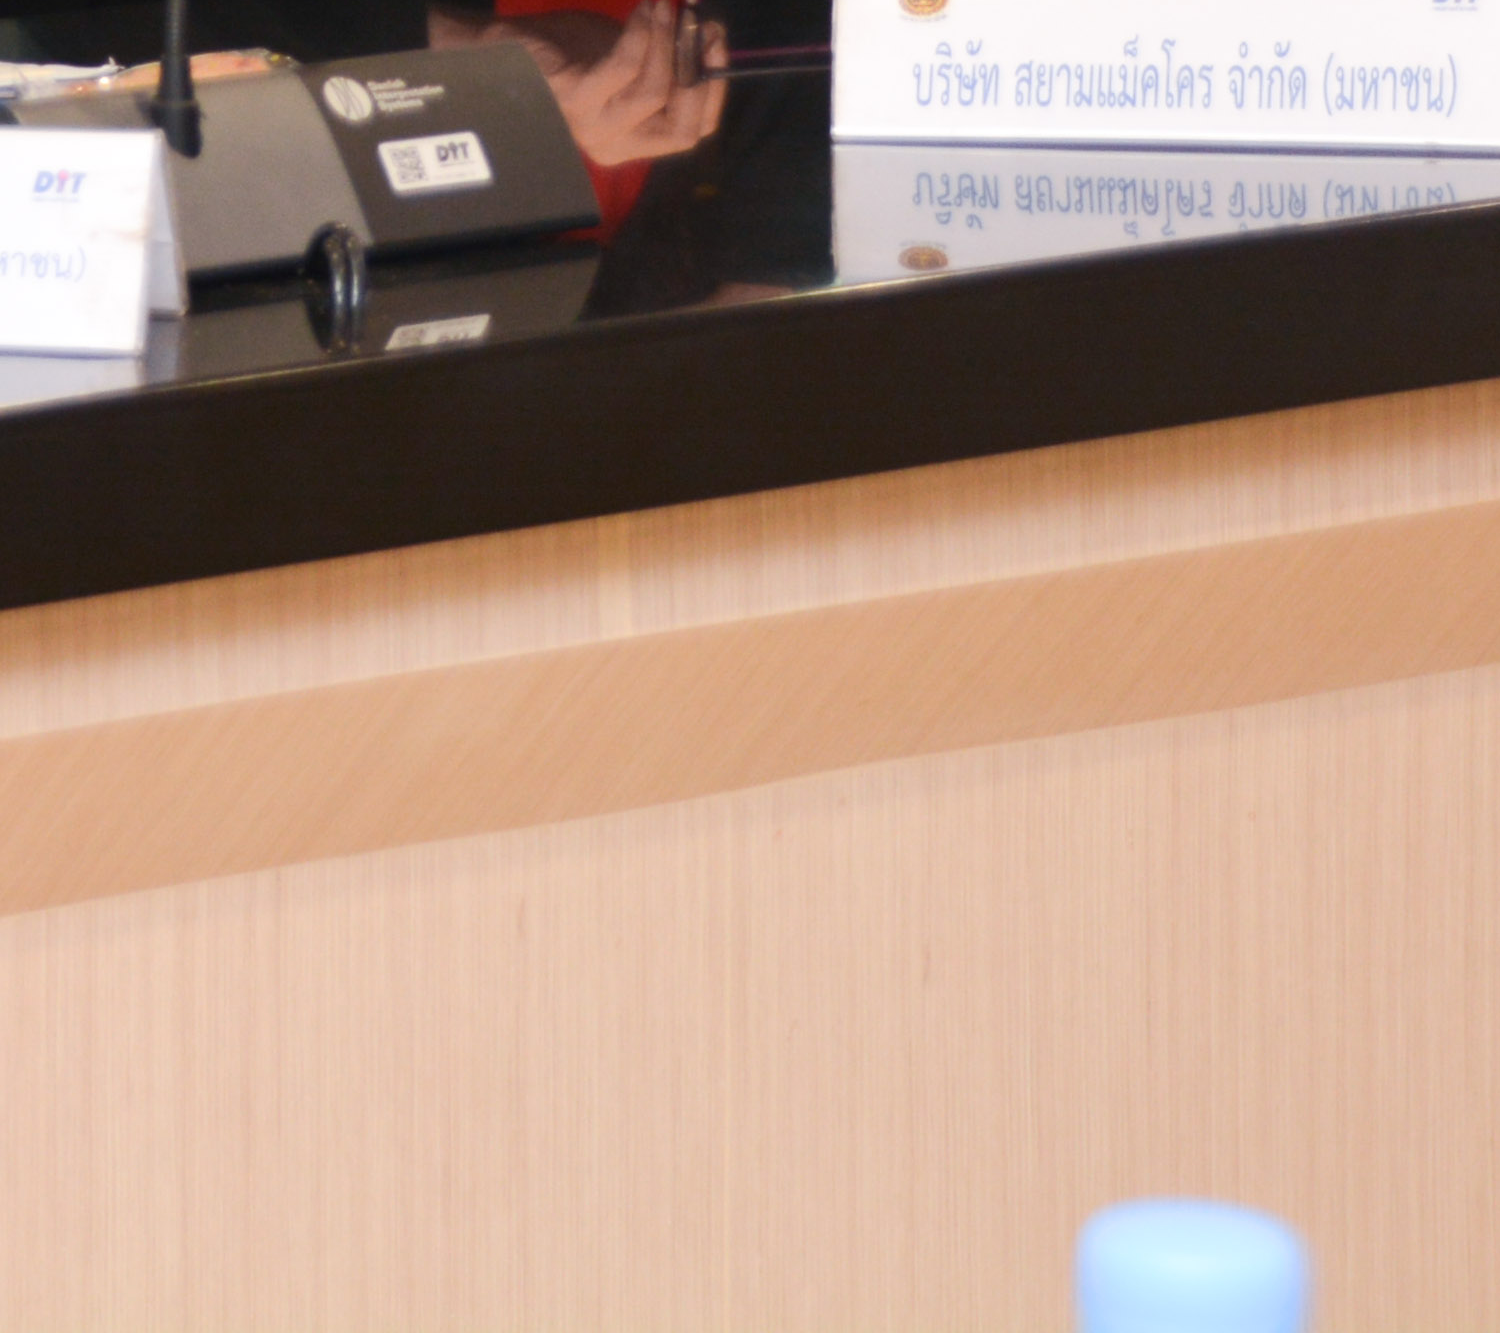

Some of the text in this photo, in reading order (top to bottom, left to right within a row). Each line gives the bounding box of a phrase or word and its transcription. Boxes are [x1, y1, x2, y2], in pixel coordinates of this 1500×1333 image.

[912, 33, 1458, 118] บริษัท สยามแม็คโคร จำกัด (มหาชน)
[33, 169, 87, 194] DIT
